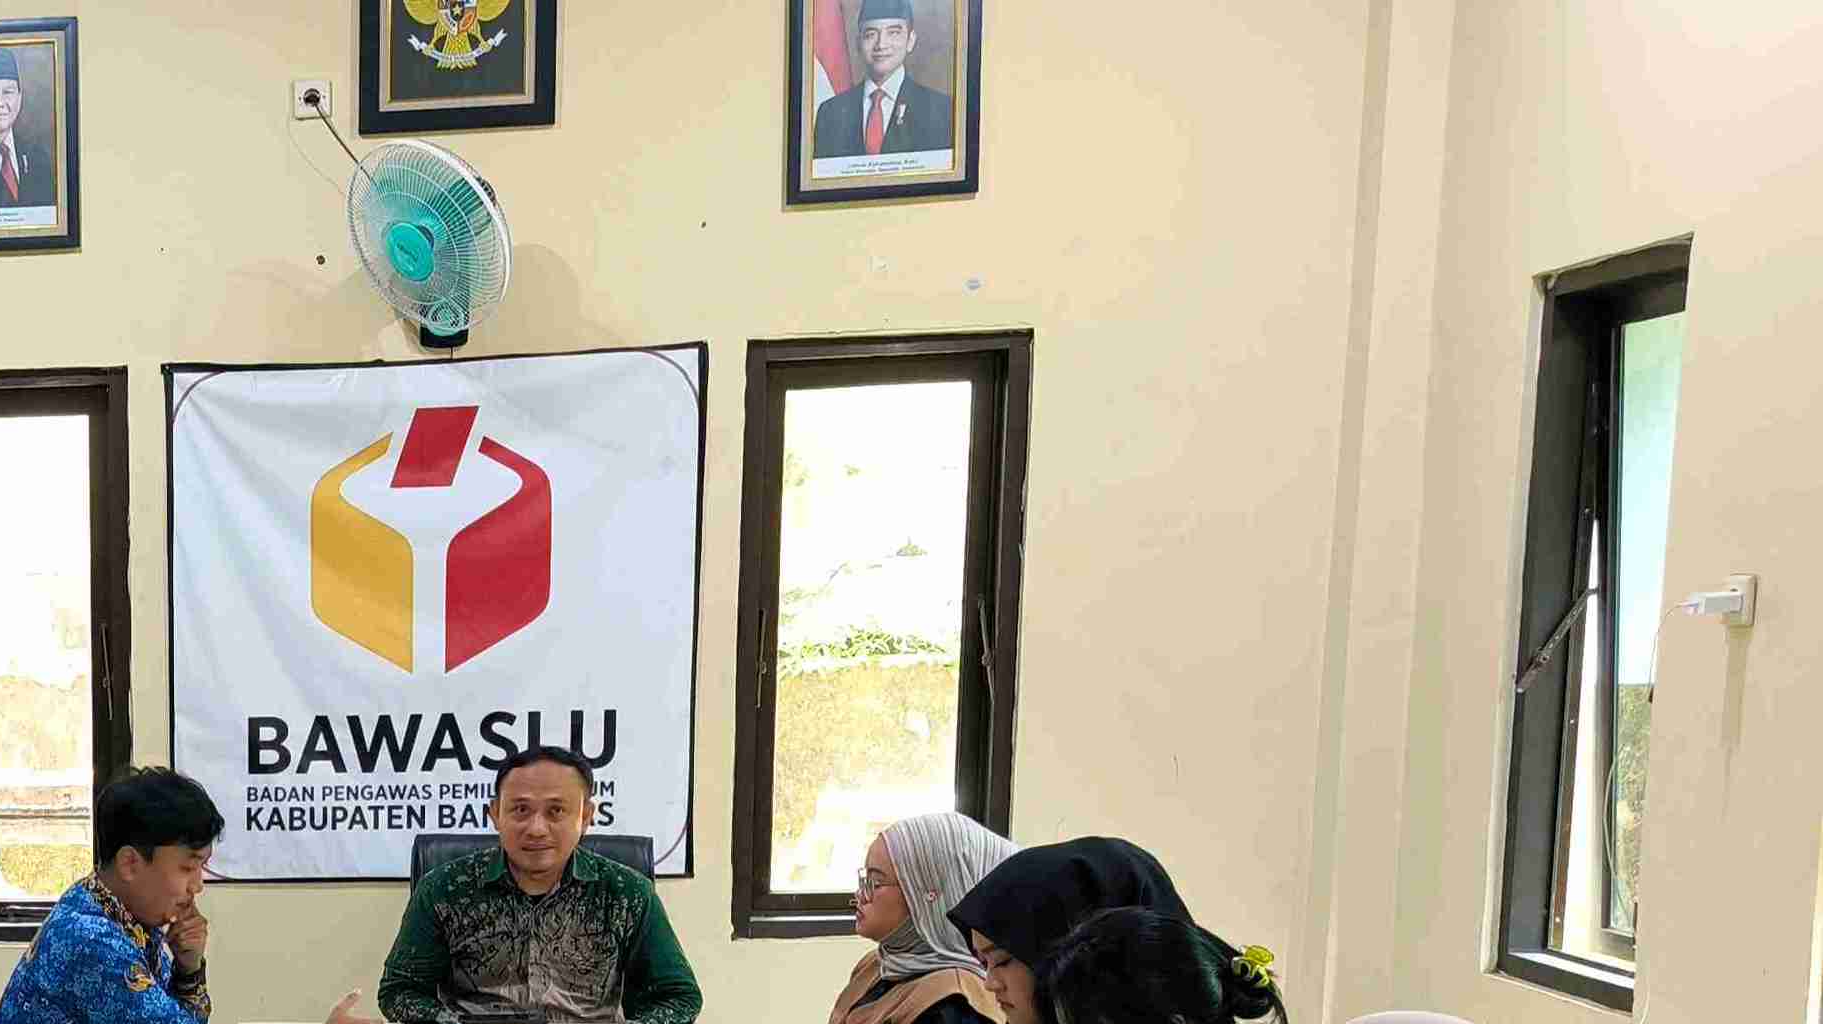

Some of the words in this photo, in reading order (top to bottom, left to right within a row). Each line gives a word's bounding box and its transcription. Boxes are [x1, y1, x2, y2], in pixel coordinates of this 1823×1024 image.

[246, 786, 315, 803] BADAN
[321, 784, 433, 802] PENGAWAS
[246, 804, 426, 832] KABUPATEN
